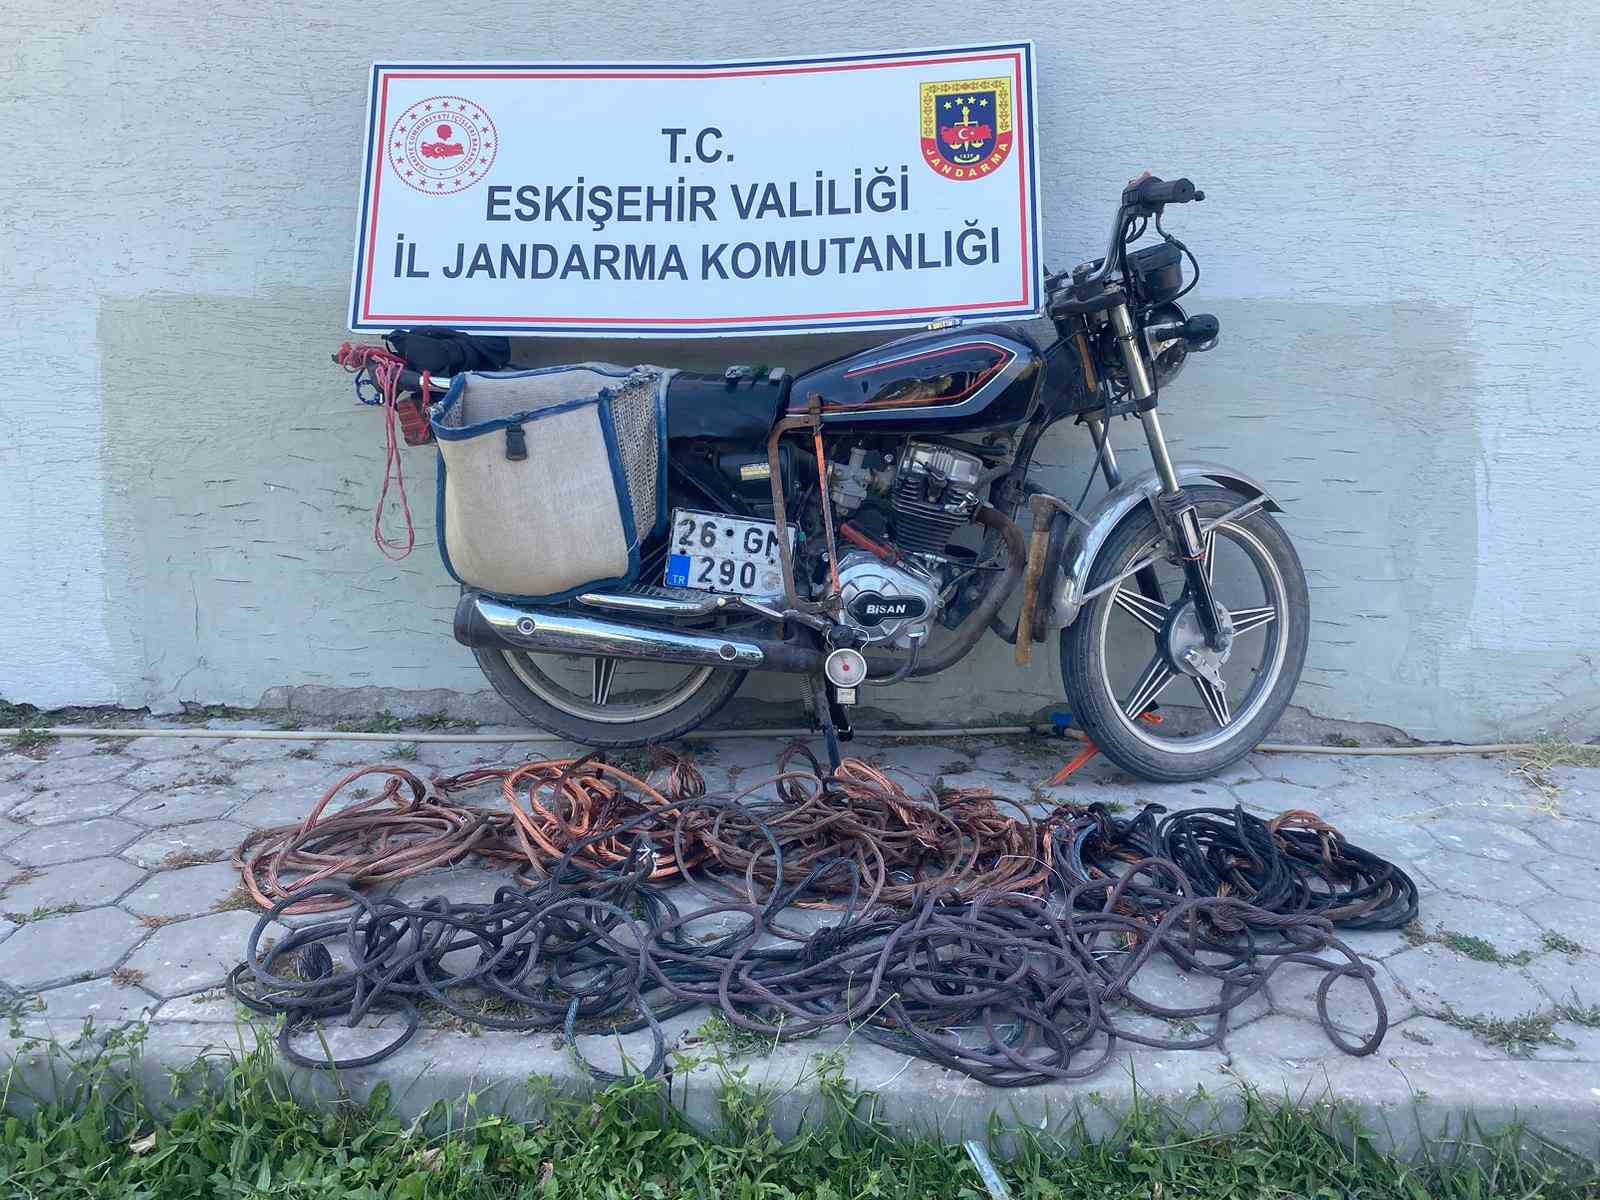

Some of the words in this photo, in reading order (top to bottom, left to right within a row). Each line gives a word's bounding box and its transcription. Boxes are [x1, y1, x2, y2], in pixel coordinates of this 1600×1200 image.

[662, 128, 734, 164] T.C.
[926, 142, 1009, 177] JANDARMA
[487, 176, 718, 232] ESKİŞEHİR
[731, 165, 909, 220] VALİLİĞİ
[394, 233, 430, 278] İL
[442, 243, 689, 281] JANDARMA
[701, 218, 1000, 281] KOMUTANLIĞI
[677, 519, 718, 548] 26
[672, 574, 686, 585] TR
[697, 556, 756, 589] 290
